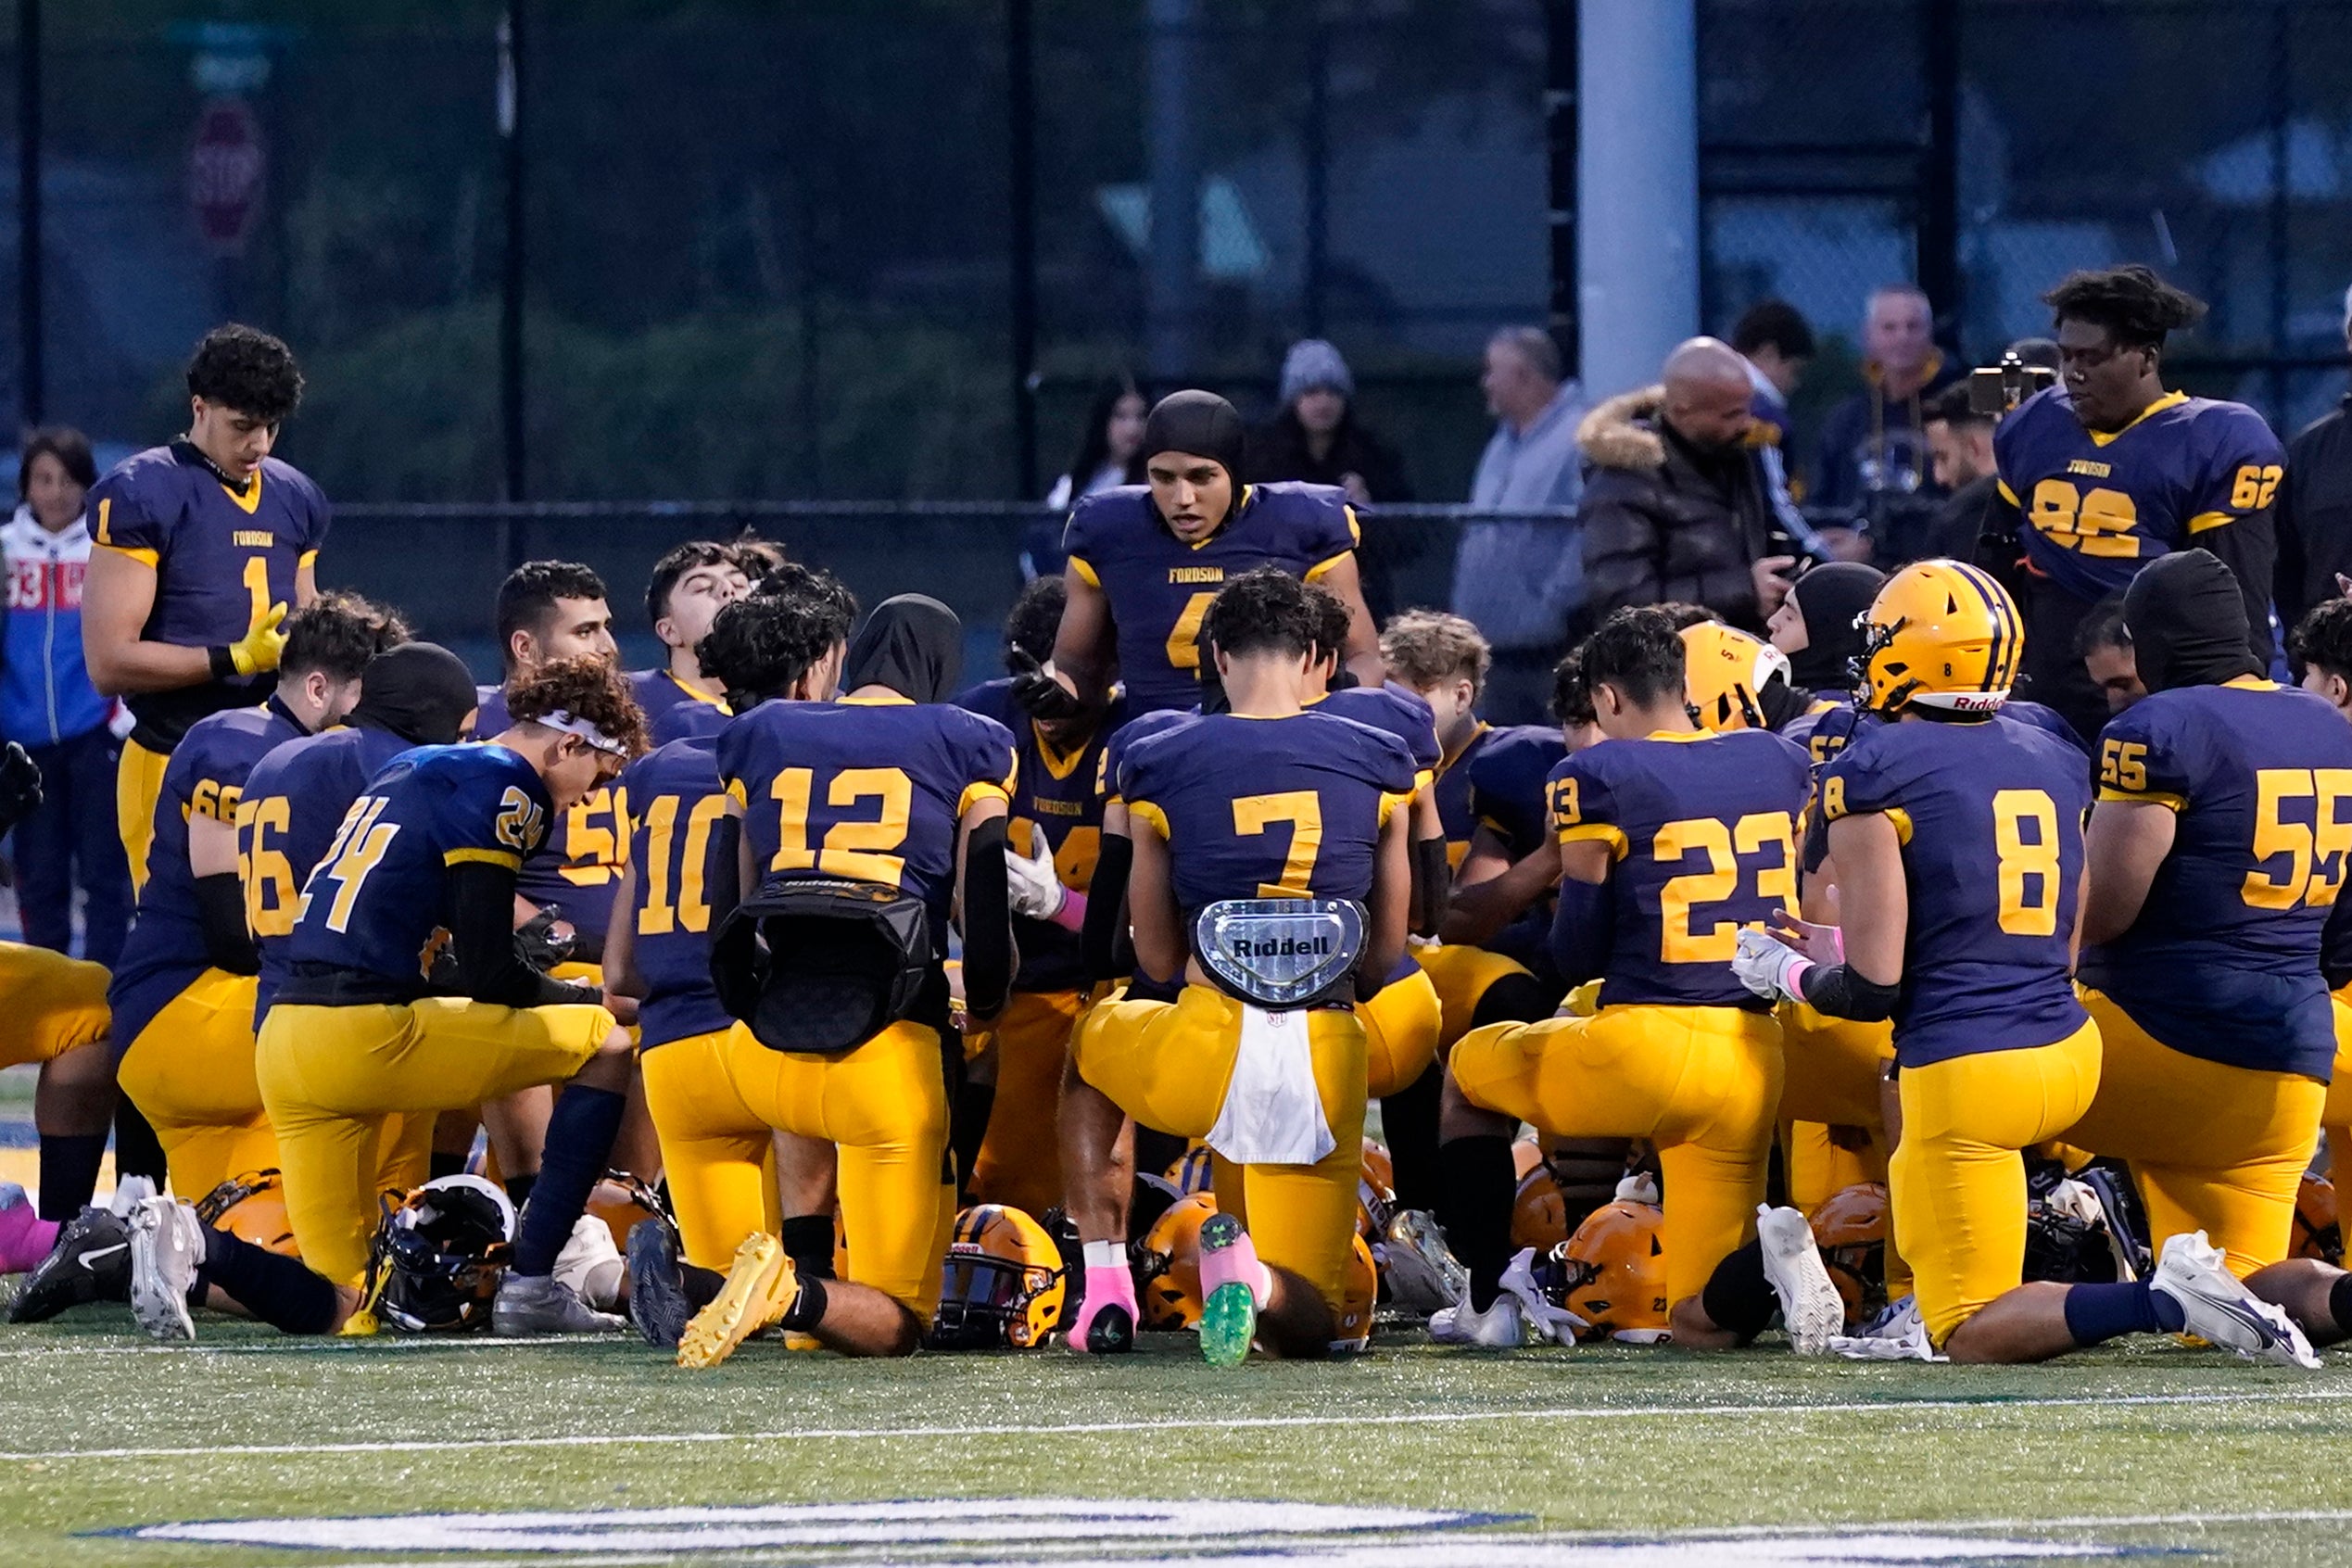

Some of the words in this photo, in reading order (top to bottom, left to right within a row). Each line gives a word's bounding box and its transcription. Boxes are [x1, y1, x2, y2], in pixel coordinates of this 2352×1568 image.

[2230, 464, 2283, 510] 62
[97, 498, 111, 545] 1
[233, 530, 273, 548] FORDSON
[243, 556, 272, 630] 1
[1168, 566, 1224, 584] FORDSON
[1943, 663, 1952, 677] 8
[2101, 739, 2147, 791] 55
[1823, 776, 1849, 820] 8
[770, 767, 913, 886] 12
[1232, 790, 1323, 899] 7
[2240, 768, 2352, 911] 55
[638, 794, 727, 935] 10
[1652, 811, 1802, 964] 23
[1992, 789, 2061, 936] 8
[1233, 936, 1328, 958] Riddell
